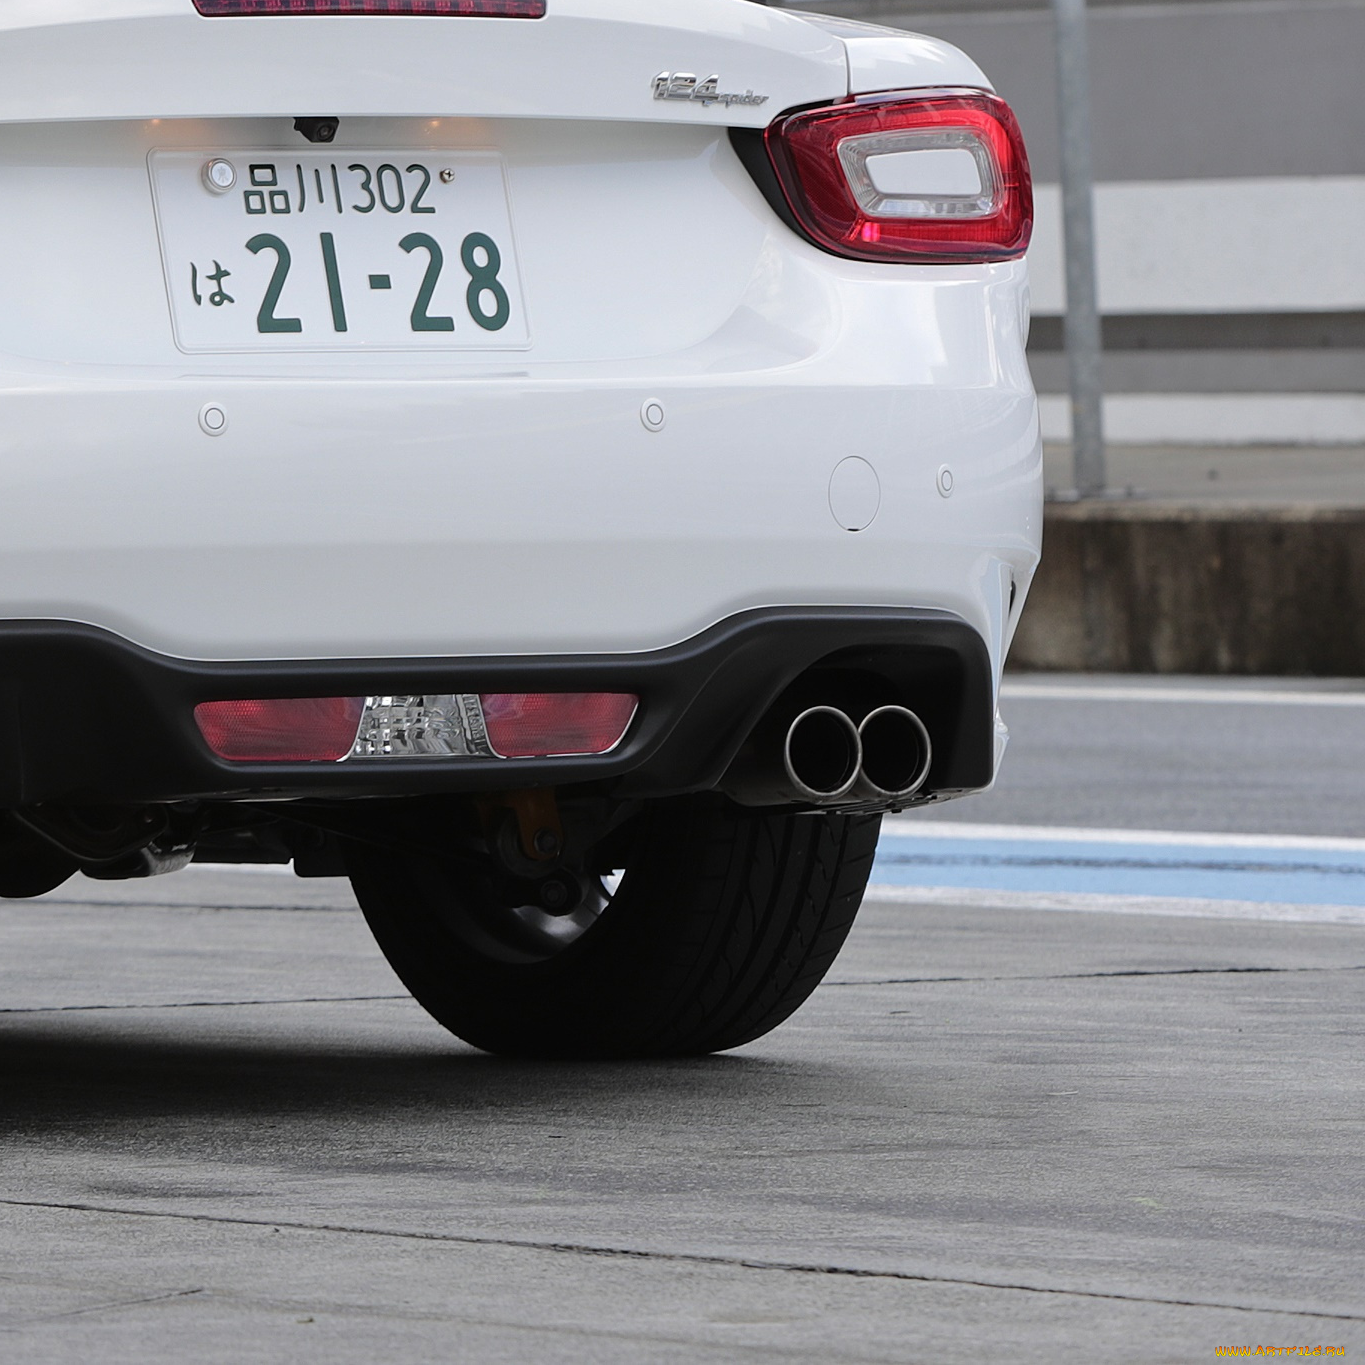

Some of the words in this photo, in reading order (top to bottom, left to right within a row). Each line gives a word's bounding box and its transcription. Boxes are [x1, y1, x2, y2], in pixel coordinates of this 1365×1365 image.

[650, 70, 720, 107] 124
[243, 162, 436, 214] 品川302
[189, 259, 236, 307] は
[245, 231, 511, 333] 21-28
